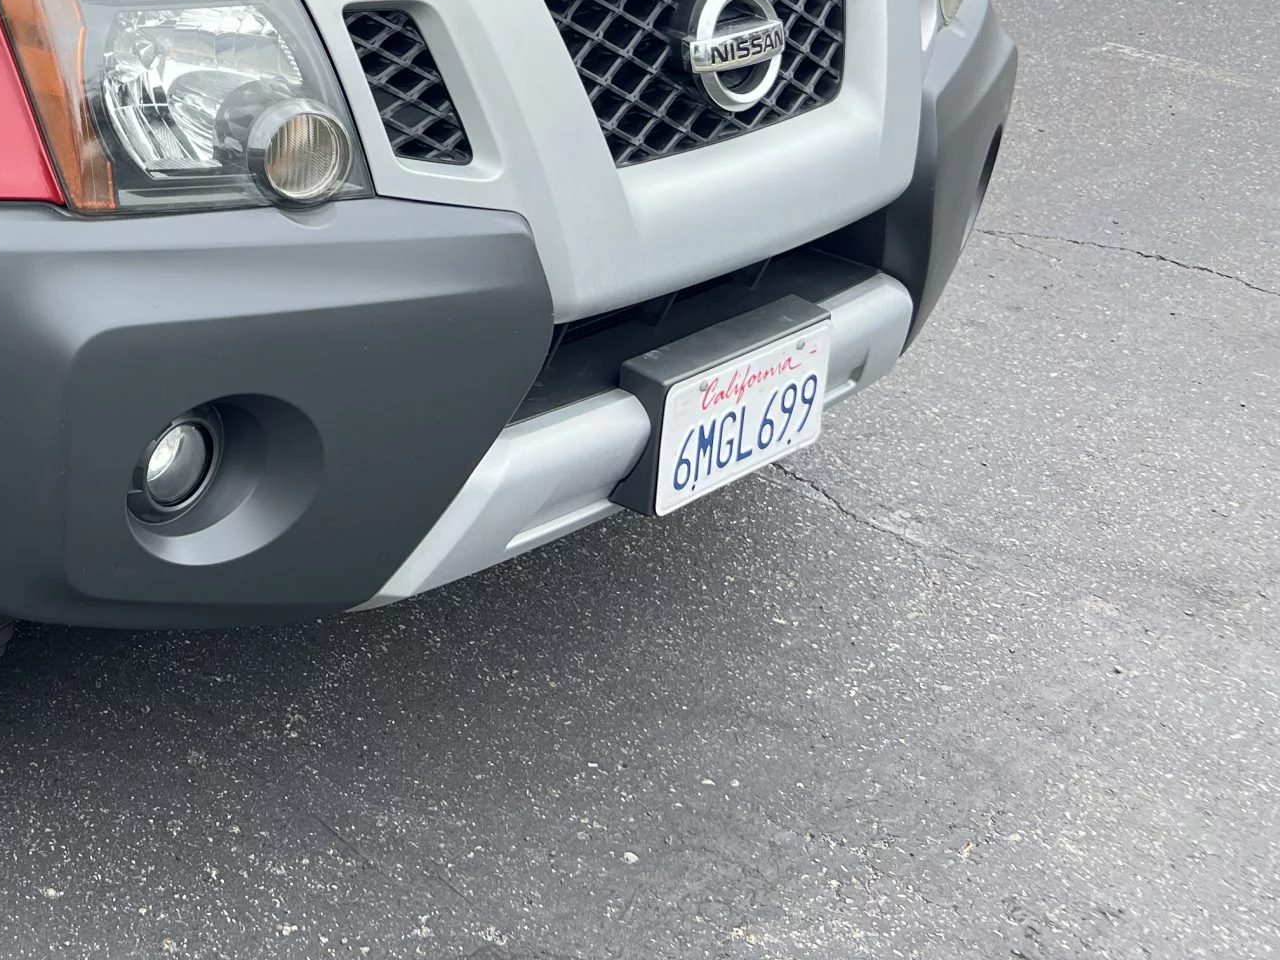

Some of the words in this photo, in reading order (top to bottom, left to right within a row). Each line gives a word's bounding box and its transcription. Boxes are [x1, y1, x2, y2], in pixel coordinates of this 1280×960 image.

[711, 31, 784, 65] NISSAN
[701, 355, 803, 411] California
[672, 373, 818, 492] 6MGL699
